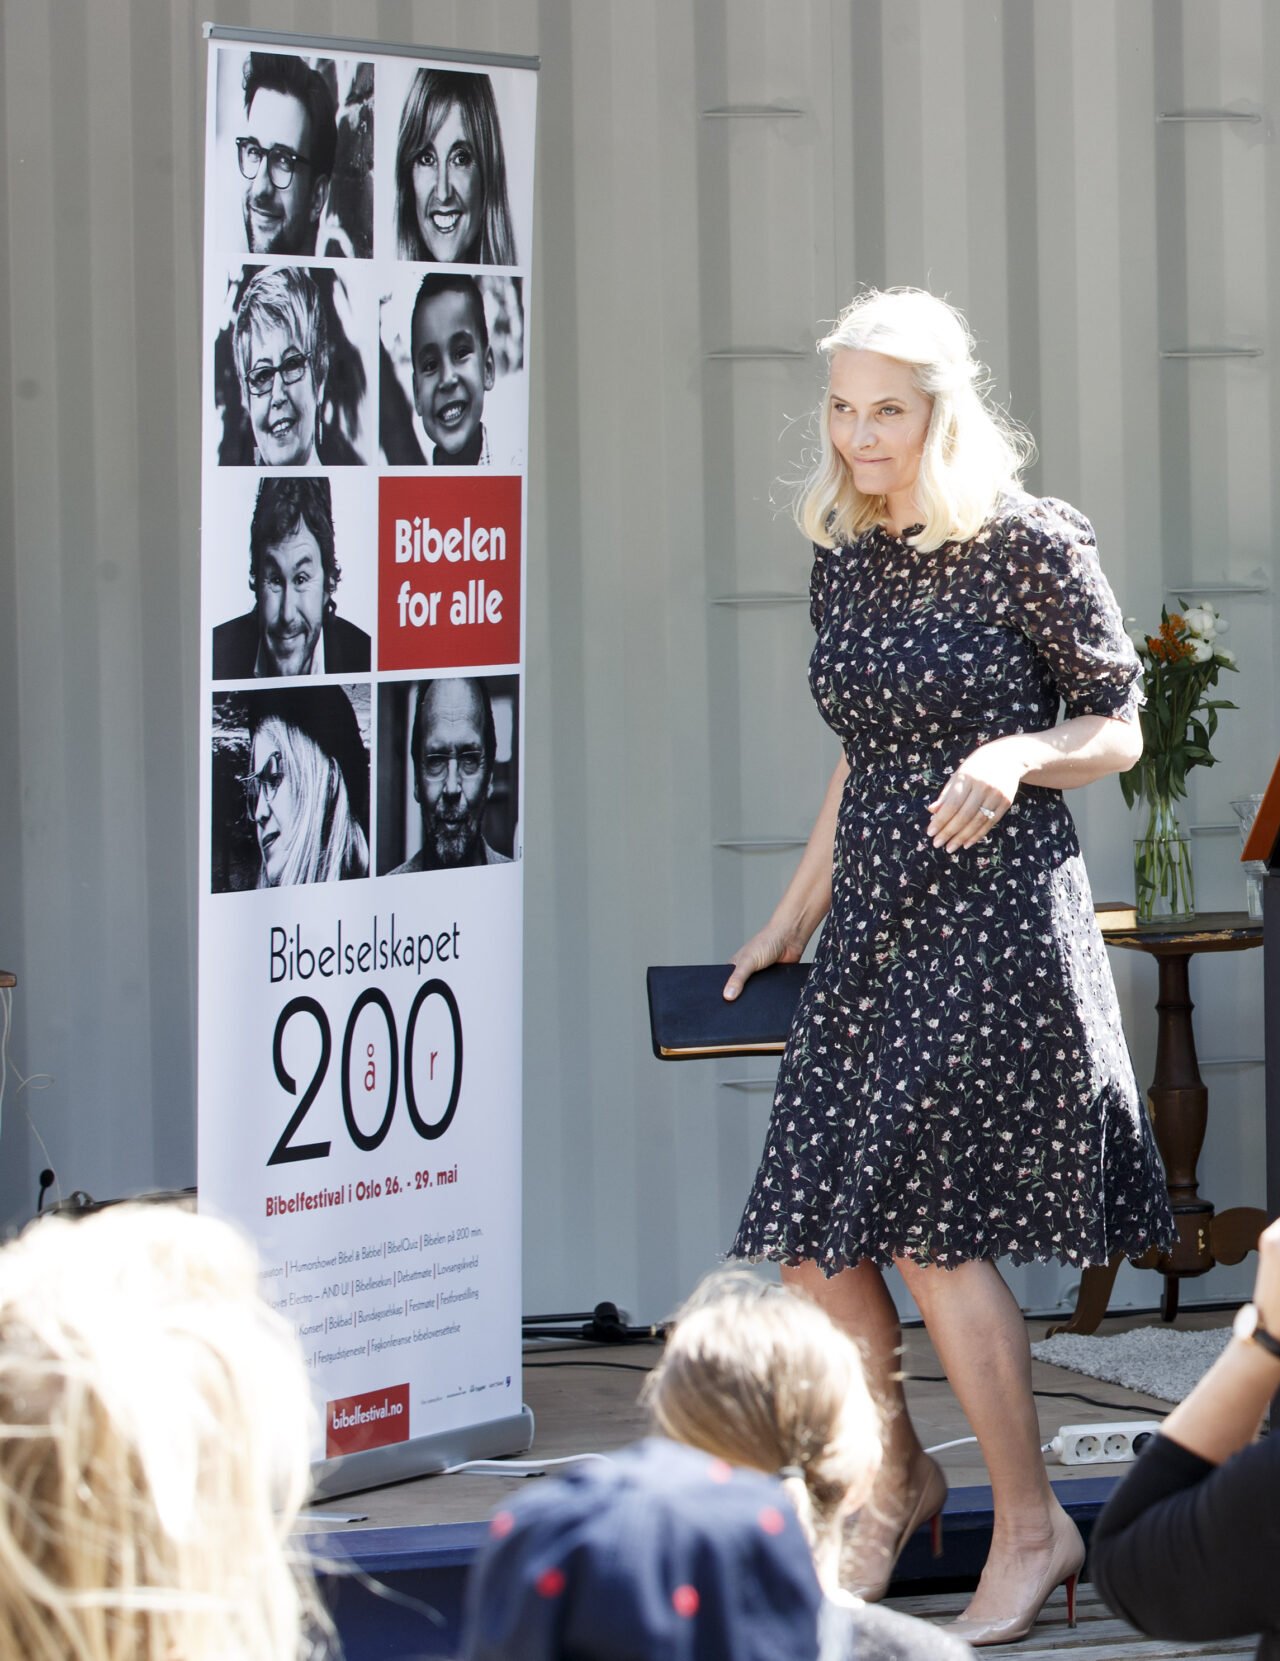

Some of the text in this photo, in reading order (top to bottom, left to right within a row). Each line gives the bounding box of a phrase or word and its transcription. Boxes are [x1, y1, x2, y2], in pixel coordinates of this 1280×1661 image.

[395, 516, 506, 563] Bibelen
[397, 579, 503, 628] for alle
[270, 912, 460, 983] Bibelselskapet
[266, 978, 463, 1166] 200
[266, 1184, 345, 1217] Bibelfestival
[348, 1183, 352, 1203] i
[355, 1179, 382, 1202] Oslo
[385, 1175, 403, 1196] 26.
[415, 1170, 433, 1190] 29.
[437, 1164, 458, 1186] mai
[332, 1397, 404, 1431] bibelfestival.no
